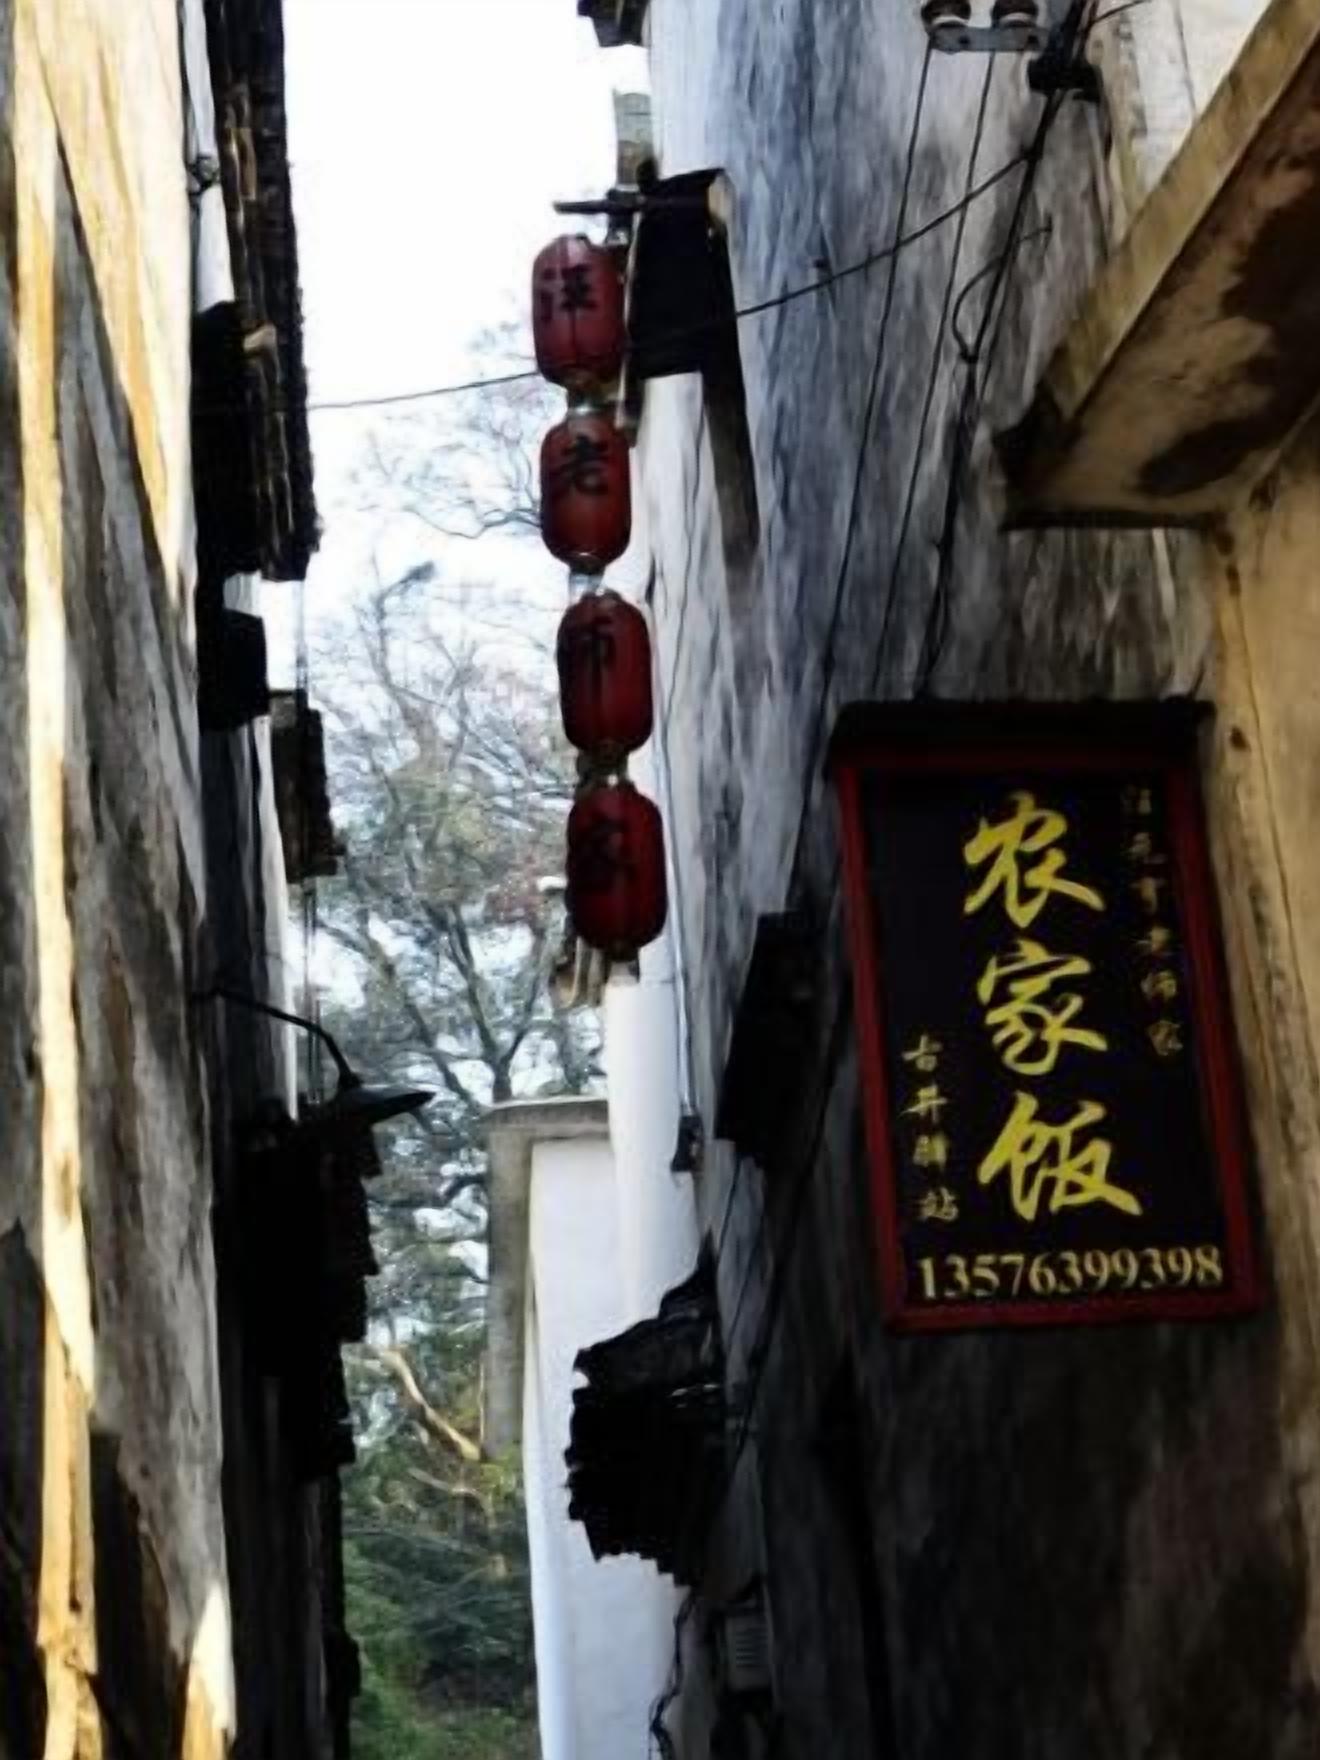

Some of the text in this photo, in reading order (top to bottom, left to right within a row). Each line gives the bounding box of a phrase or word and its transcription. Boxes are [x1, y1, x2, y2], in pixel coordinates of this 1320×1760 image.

[962, 790, 1143, 1221] 农家饭
[917, 1245, 1222, 1299] 13576399398
